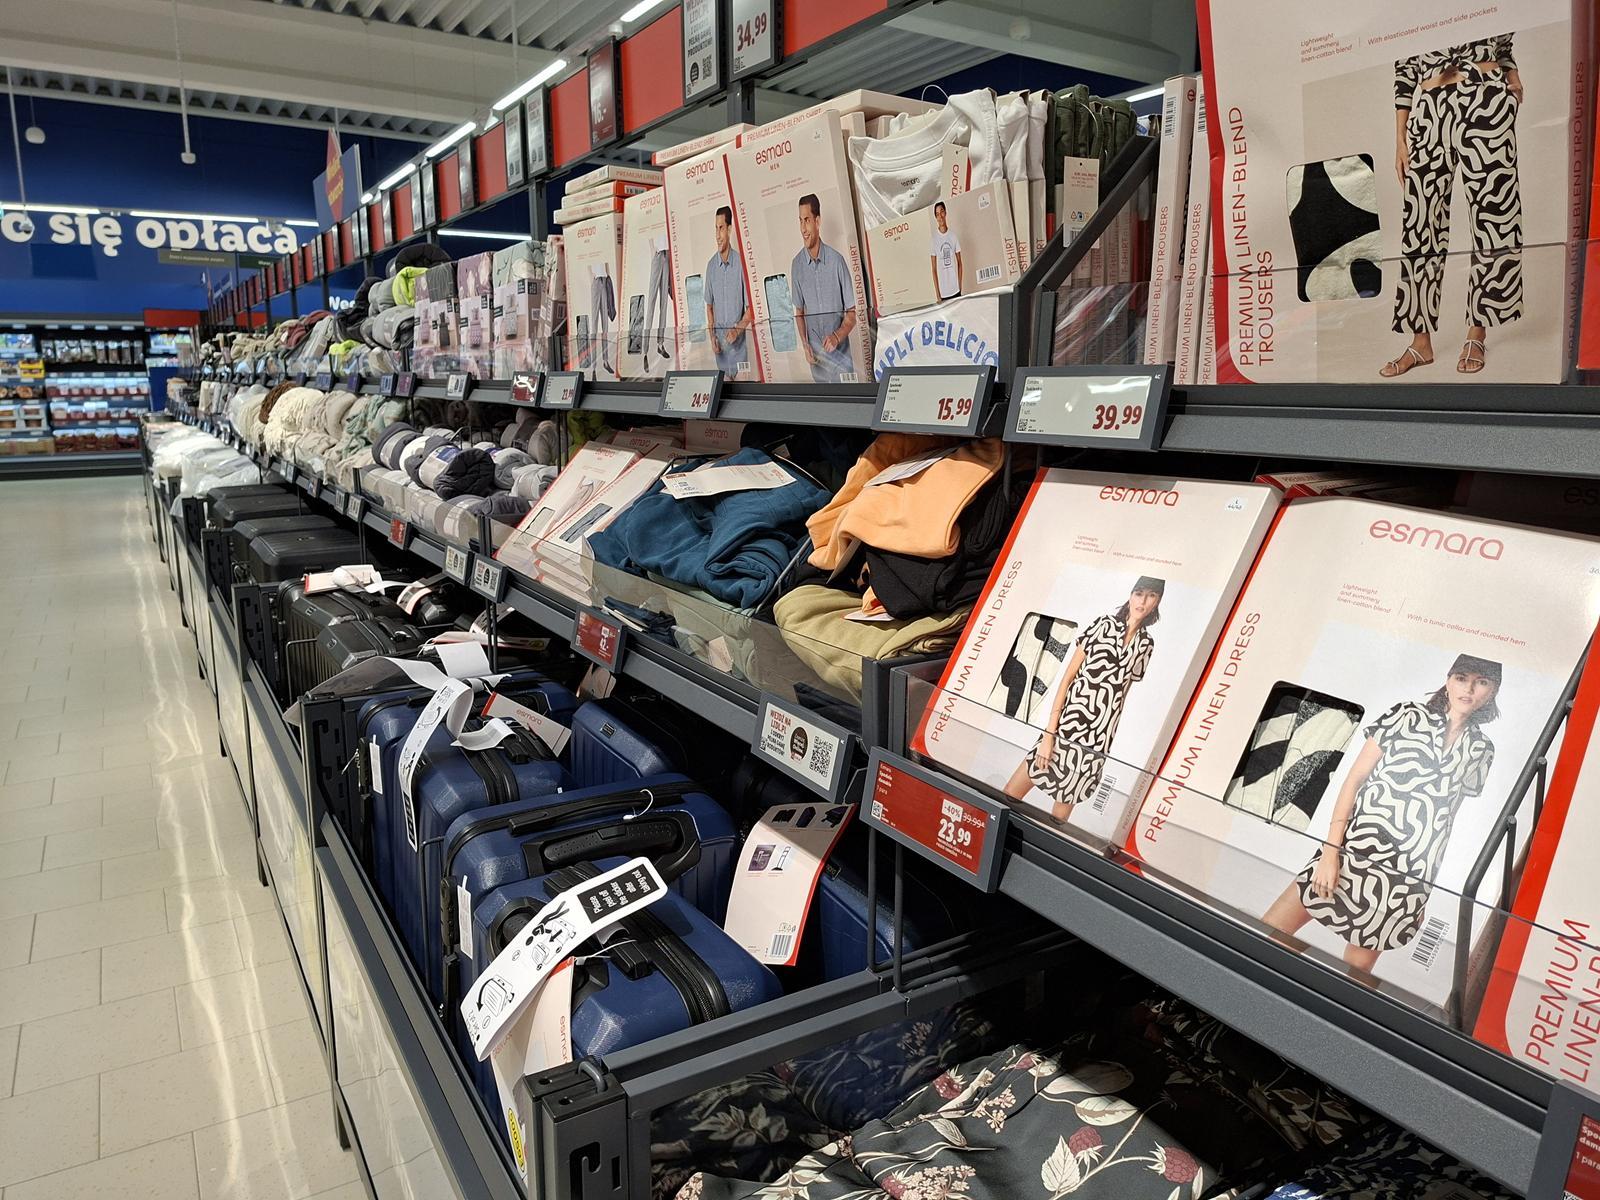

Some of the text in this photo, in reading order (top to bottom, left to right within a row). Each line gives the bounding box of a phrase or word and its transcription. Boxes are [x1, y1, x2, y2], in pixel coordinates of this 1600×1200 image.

[737, 12, 767, 52] 34.99
[1301, 32, 1334, 47] Lightweight
[1367, 6, 1498, 45] With elasticated waist and side pockets
[1313, 40, 1340, 52] summery
[1573, 61, 1583, 151] TROUSERS
[755, 140, 793, 165] esmara
[685, 159, 714, 180] esmara
[49, 213, 123, 257] się
[136, 218, 298, 255] opłaca
[884, 222, 909, 240] esmara
[1157, 206, 1169, 263] TROUSERS
[1229, 106, 1254, 366] PREMIUM LINEN-BLEND
[850, 244, 860, 273] SHIRT
[1005, 237, 1018, 276] T-SHIRT
[855, 274, 872, 336] LINEN-BLEND
[1152, 264, 1164, 335] LINEN-BLEND
[1179, 203, 1202, 384] PREMIUM LINEN-BLEND TROUSERS
[1258, 250, 1273, 367] TROUSERS
[921, 320, 998, 367] DELICIO
[937, 397, 973, 421] 15.99
[1092, 404, 1143, 430] 39.99
[1099, 484, 1180, 507] esmara
[1369, 518, 1505, 561] esmara
[1343, 583, 1378, 596] Lightweight
[1352, 592, 1381, 604] summery
[1373, 603, 1392, 614] blend
[1407, 613, 1422, 623] With
[1429, 619, 1446, 628] tunic
[1446, 623, 1465, 633] collar
[1465, 626, 1480, 635] and
[1480, 631, 1509, 643] rounded
[1509, 636, 1527, 647] hem
[930, 560, 1023, 742] PREMIUM LINEN DRESS
[516, 708, 543, 726] esmara
[1144, 612, 1261, 843] PREMIUM LINEN DRESS
[943, 804, 961, 818] -40%
[937, 818, 971, 846] 23.99
[589, 895, 603, 914] Please
[1525, 919, 1591, 1066] PREMIUM
[1576, 1151, 1580, 1159] 1
